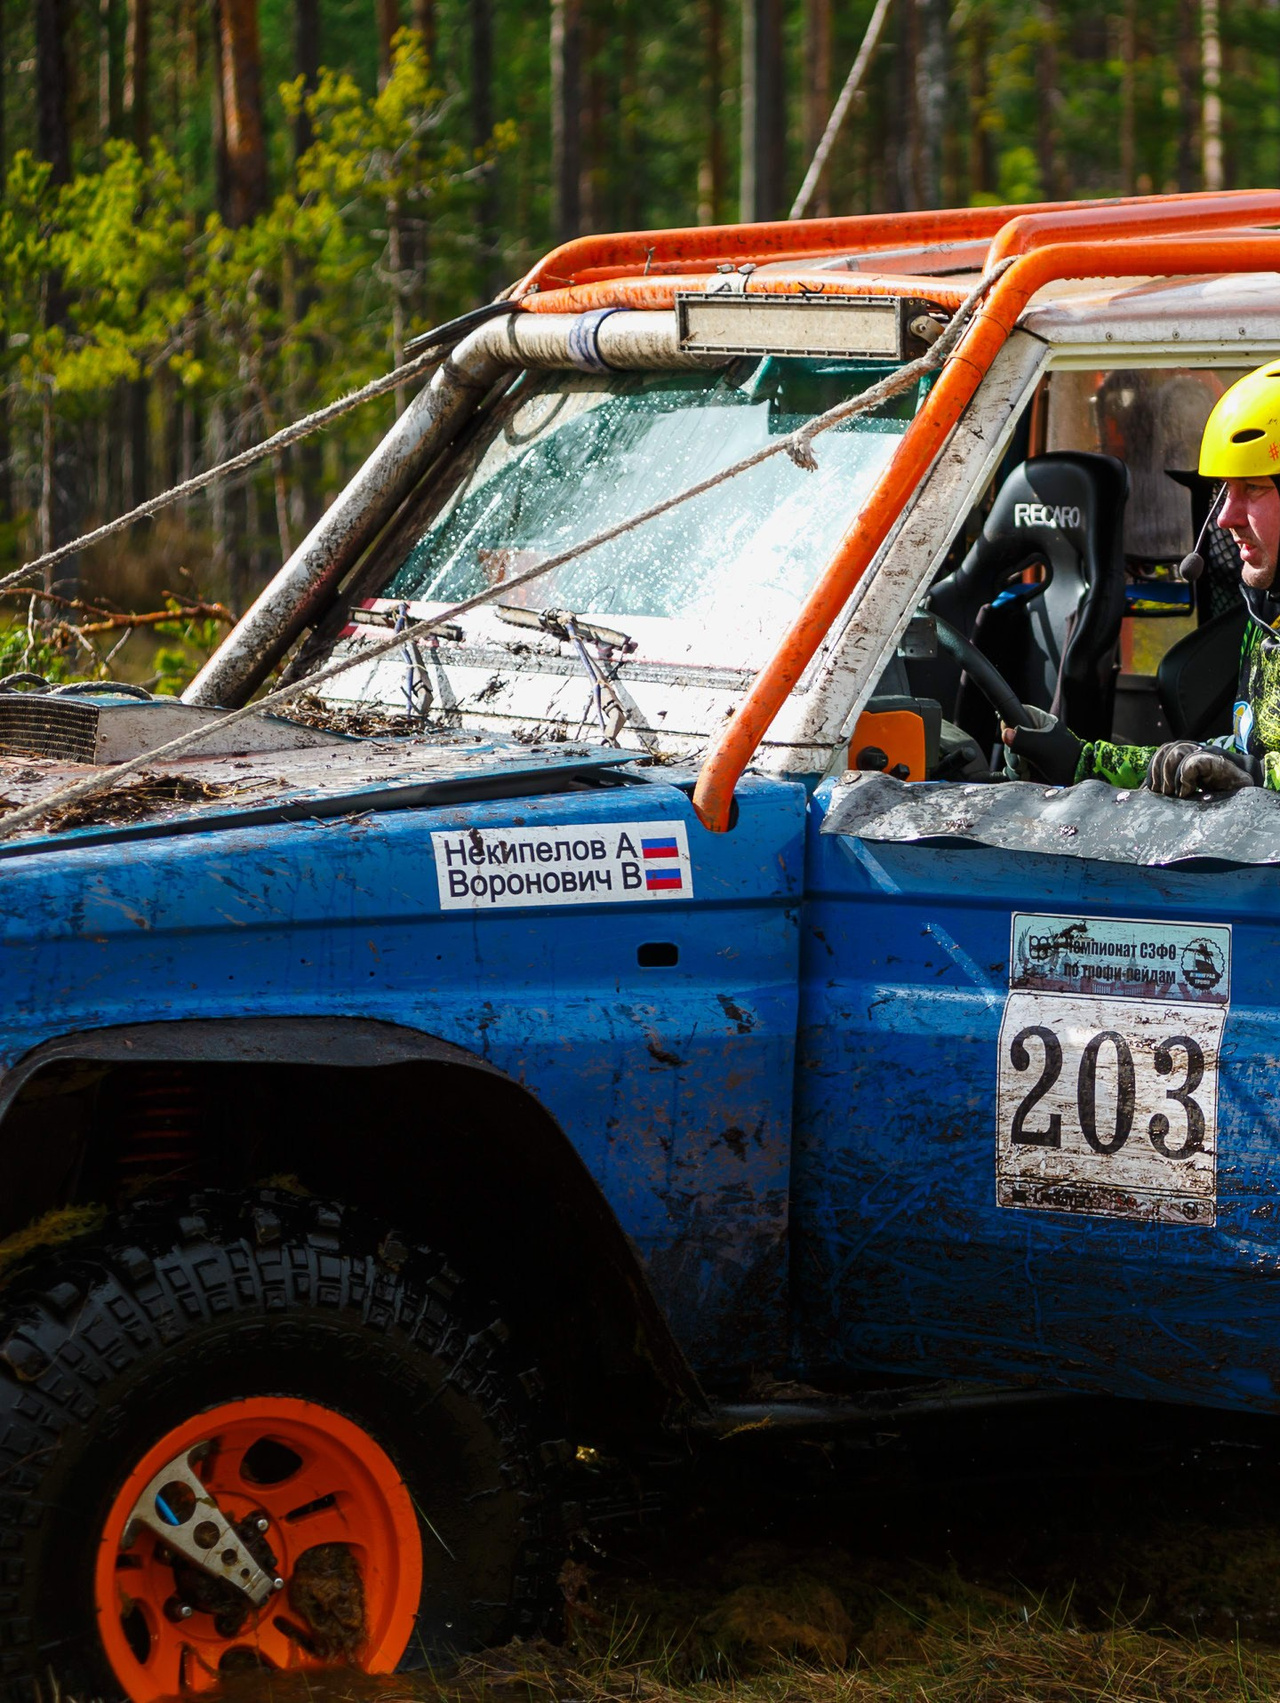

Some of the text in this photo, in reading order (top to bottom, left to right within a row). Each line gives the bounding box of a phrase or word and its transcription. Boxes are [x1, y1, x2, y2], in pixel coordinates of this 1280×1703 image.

[1015, 503, 1081, 528] RECARO
[444, 832, 638, 867] Некипелов А
[448, 862, 642, 902] Воронович В
[1064, 962, 1080, 978] по
[1010, 1025, 1206, 1160] 203
